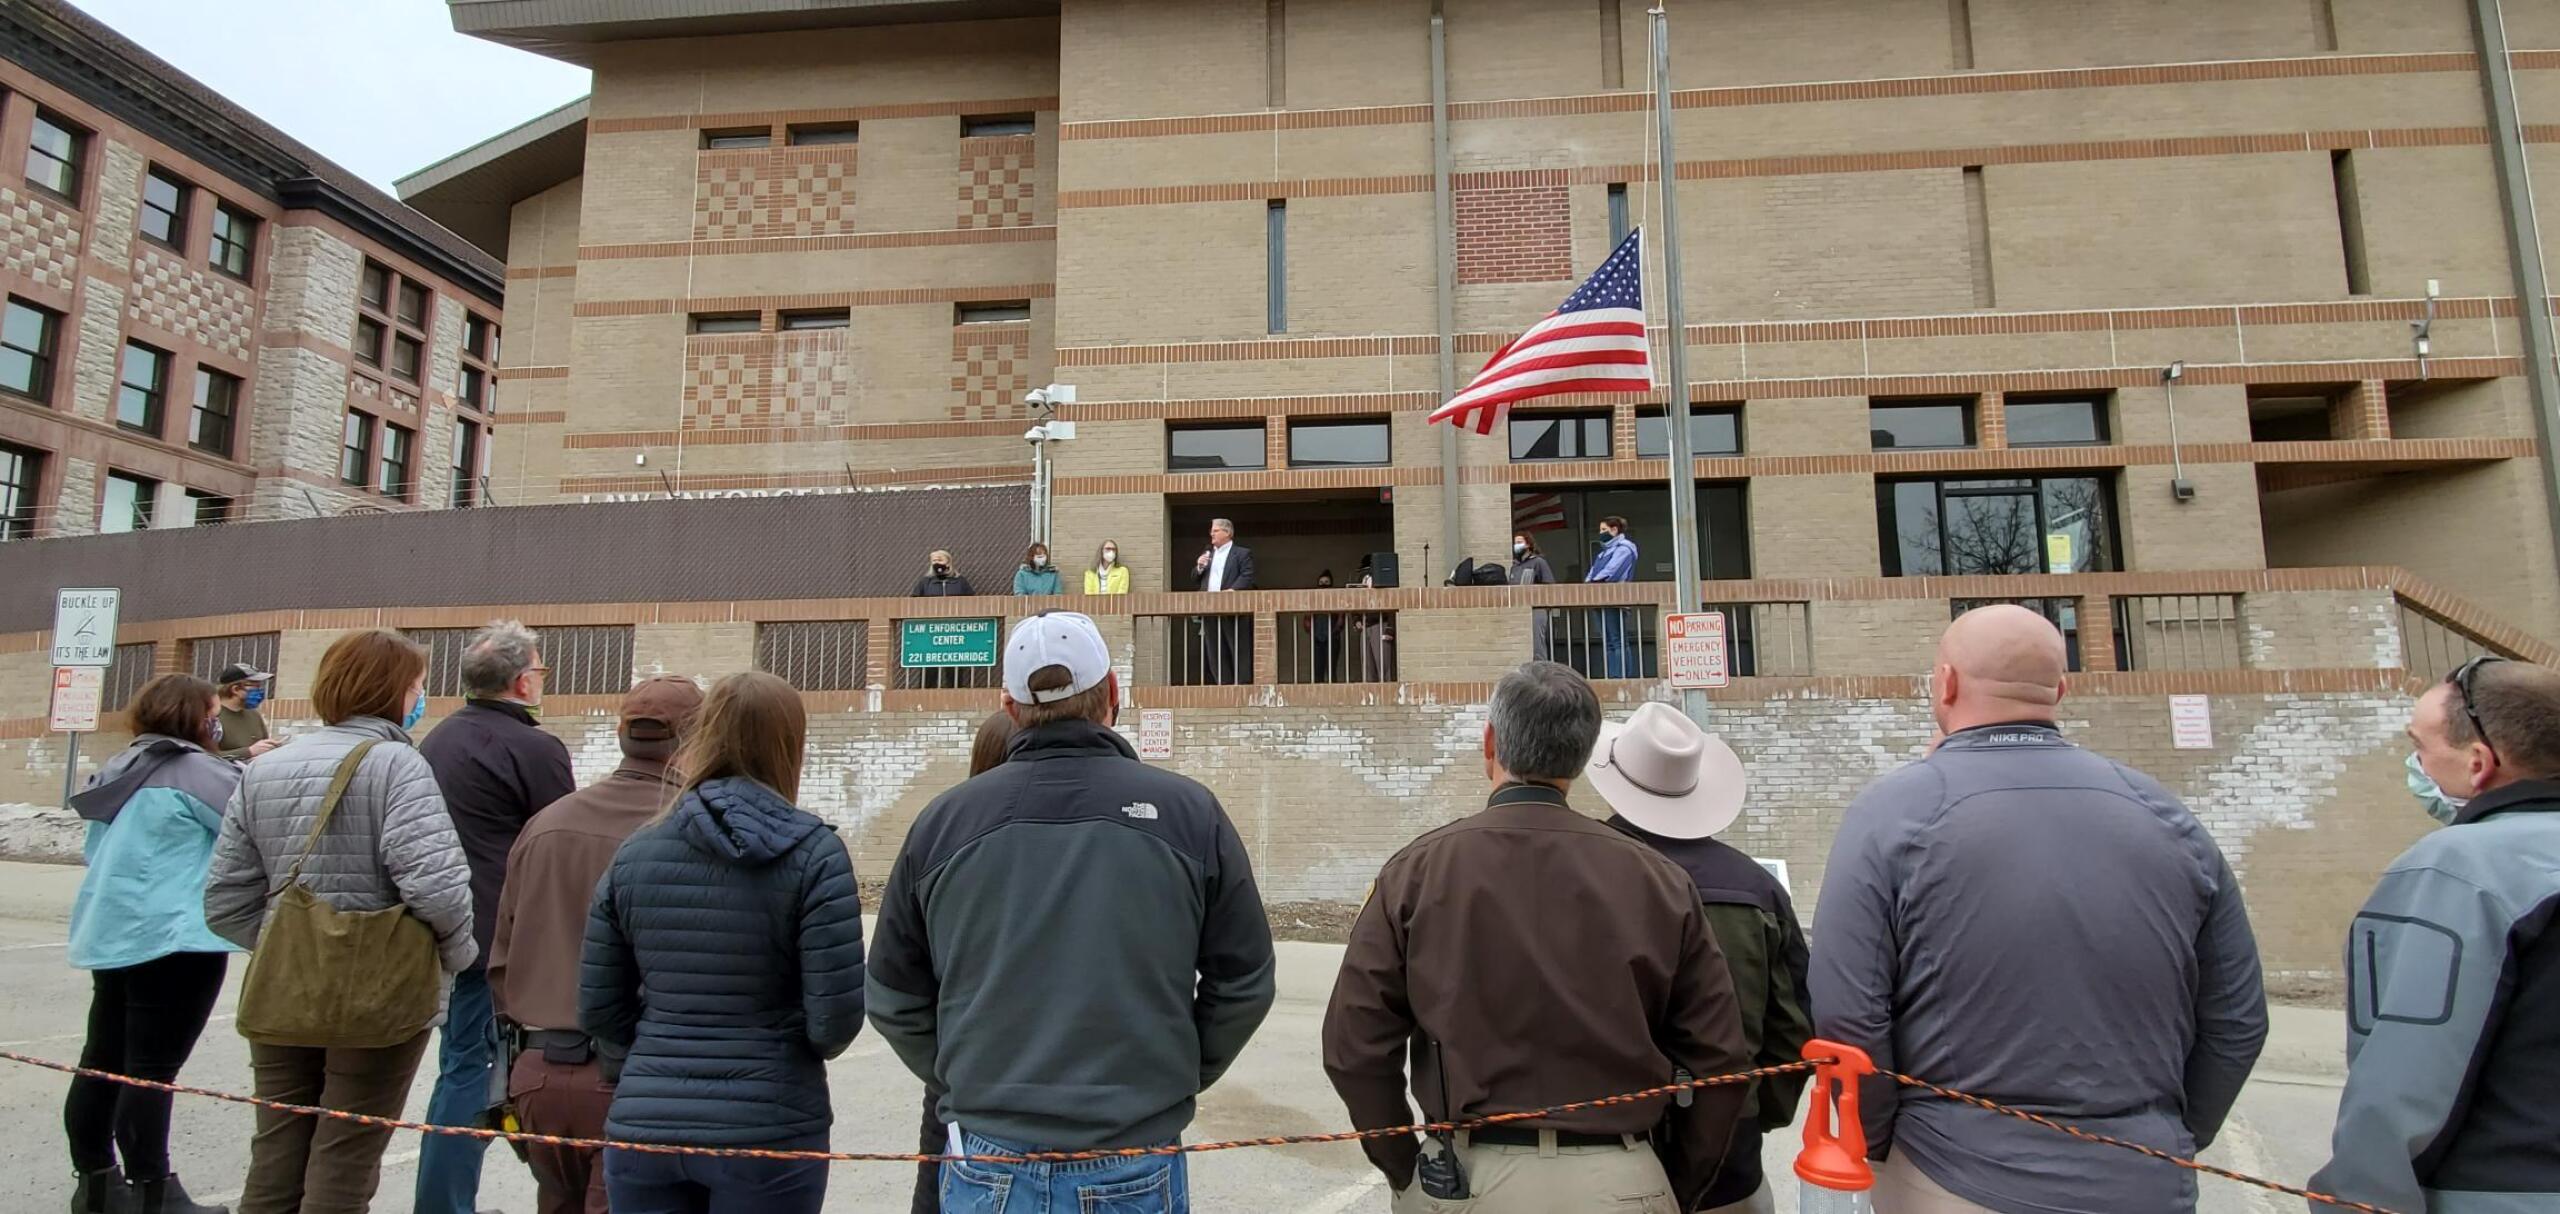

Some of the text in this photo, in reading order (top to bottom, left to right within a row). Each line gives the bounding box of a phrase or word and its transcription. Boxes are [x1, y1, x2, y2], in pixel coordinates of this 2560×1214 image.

[61, 596, 115, 609] BUCKLE UP
[909, 623, 988, 633] LAW ENFORCEMENT
[1669, 619, 1721, 635] NO PARKING
[932, 635, 965, 646] CENTER
[74, 647, 89, 659] THE
[92, 646, 109, 658] LAW
[1673, 641, 1721, 653] EMERGENCY
[908, 651, 989, 663] 221 BRECKENRIDGE
[1673, 655, 1721, 666] VEHICLES
[1686, 670, 1711, 680] ONLY
[1989, 733, 2044, 743] NIKE PRO
